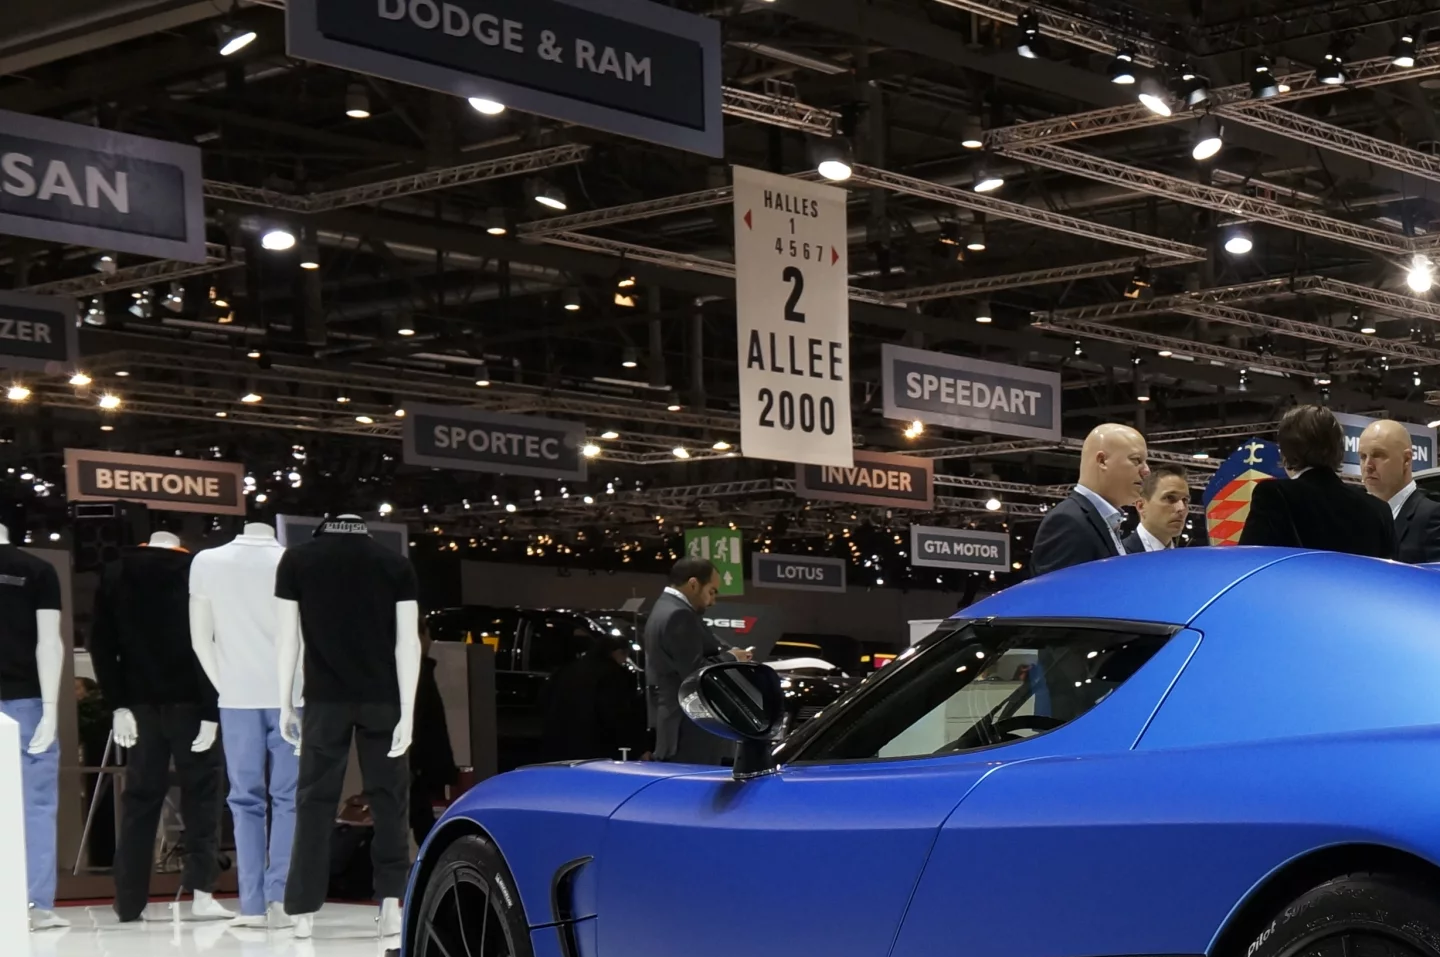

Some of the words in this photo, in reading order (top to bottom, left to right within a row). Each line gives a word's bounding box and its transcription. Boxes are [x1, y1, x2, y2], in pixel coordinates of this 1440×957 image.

[378, 0, 524, 53] DODGE
[537, 30, 563, 63] &
[575, 38, 652, 86] RAM
[0, 152, 130, 214] SAN
[764, 190, 819, 218] HALLES
[789, 218, 796, 235] 1
[775, 237, 784, 255] 4
[789, 240, 797, 257] 5
[803, 243, 810, 260] 6
[816, 245, 824, 262] 7
[782, 266, 806, 323] 2
[747, 329, 843, 381] ALLEE
[906, 371, 1041, 417] SPEEDART
[758, 387, 835, 435] 2000
[433, 424, 560, 461] SPORTEC
[96, 468, 219, 497] BERTONE
[821, 464, 912, 492] INVADER
[924, 540, 951, 555] GTA
[953, 542, 999, 559] MOTOR
[776, 564, 824, 581] LOTUS
